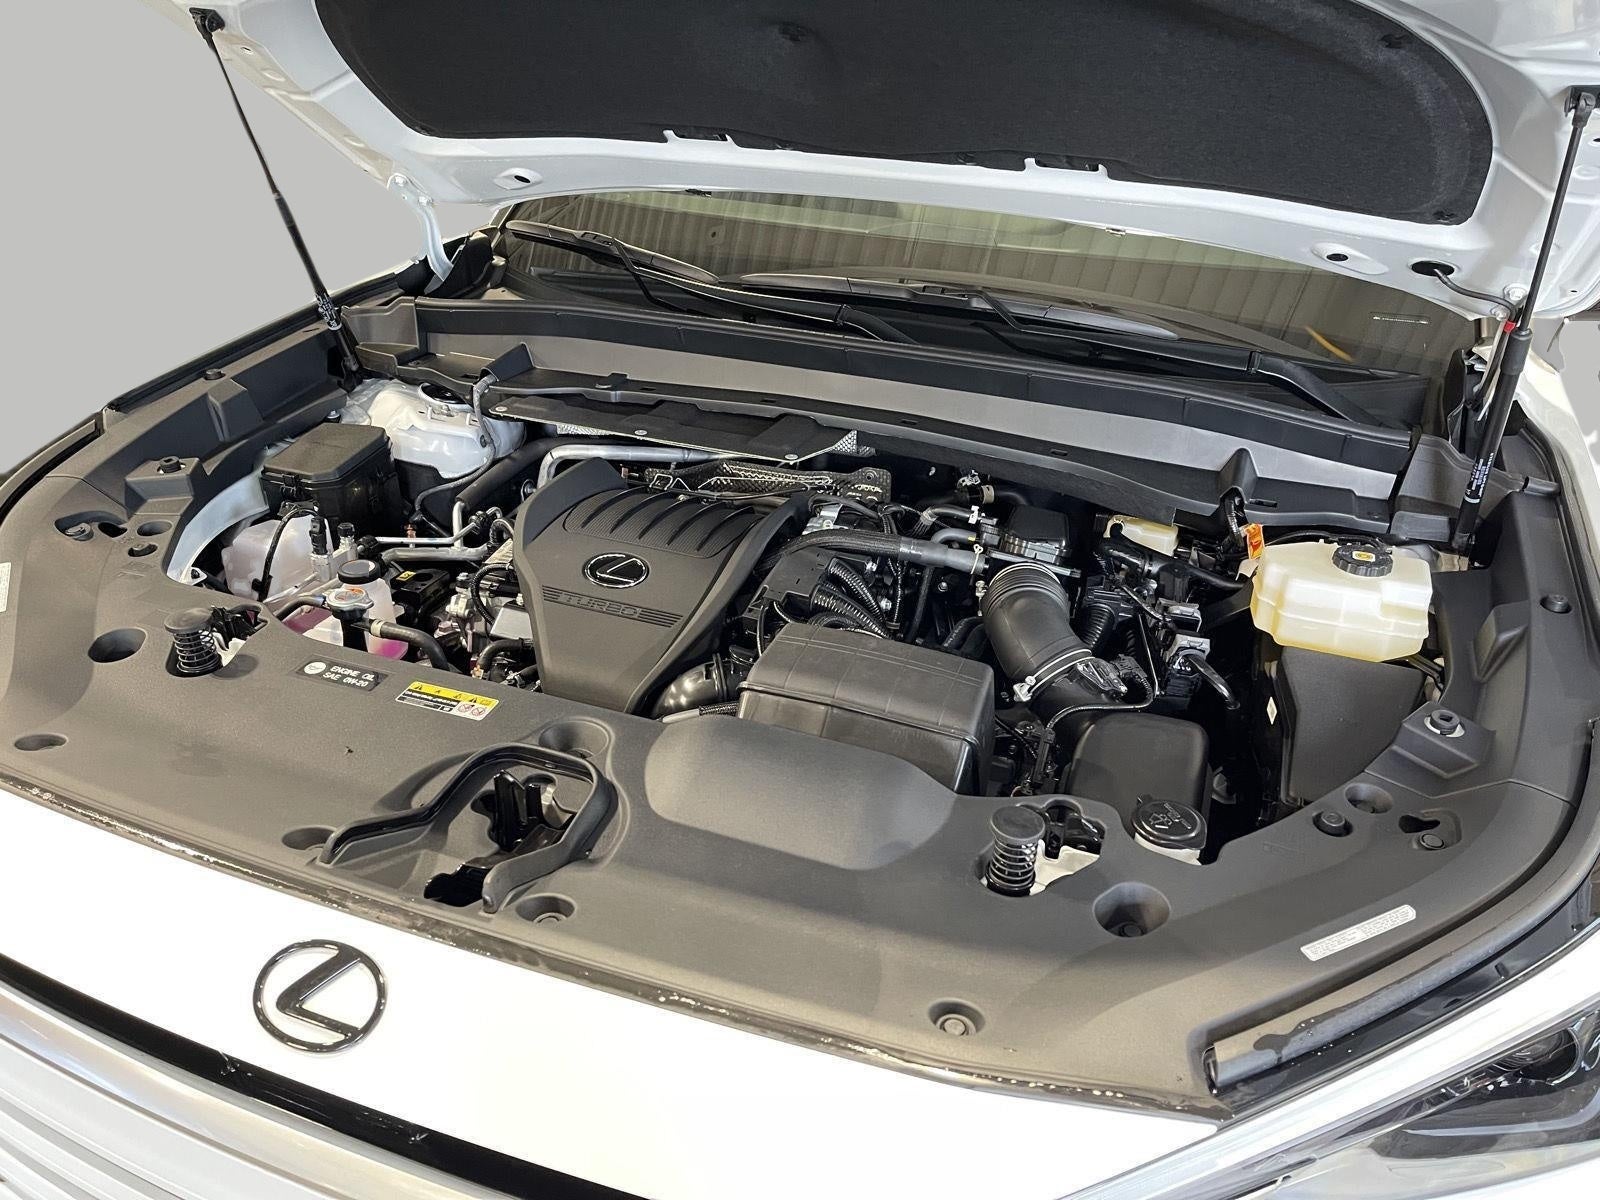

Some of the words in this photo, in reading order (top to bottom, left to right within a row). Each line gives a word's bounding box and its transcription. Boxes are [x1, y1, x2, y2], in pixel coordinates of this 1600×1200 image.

[562, 593, 638, 616] TURBO
[322, 671, 340, 681] SAE
[330, 665, 361, 677] ENGINE
